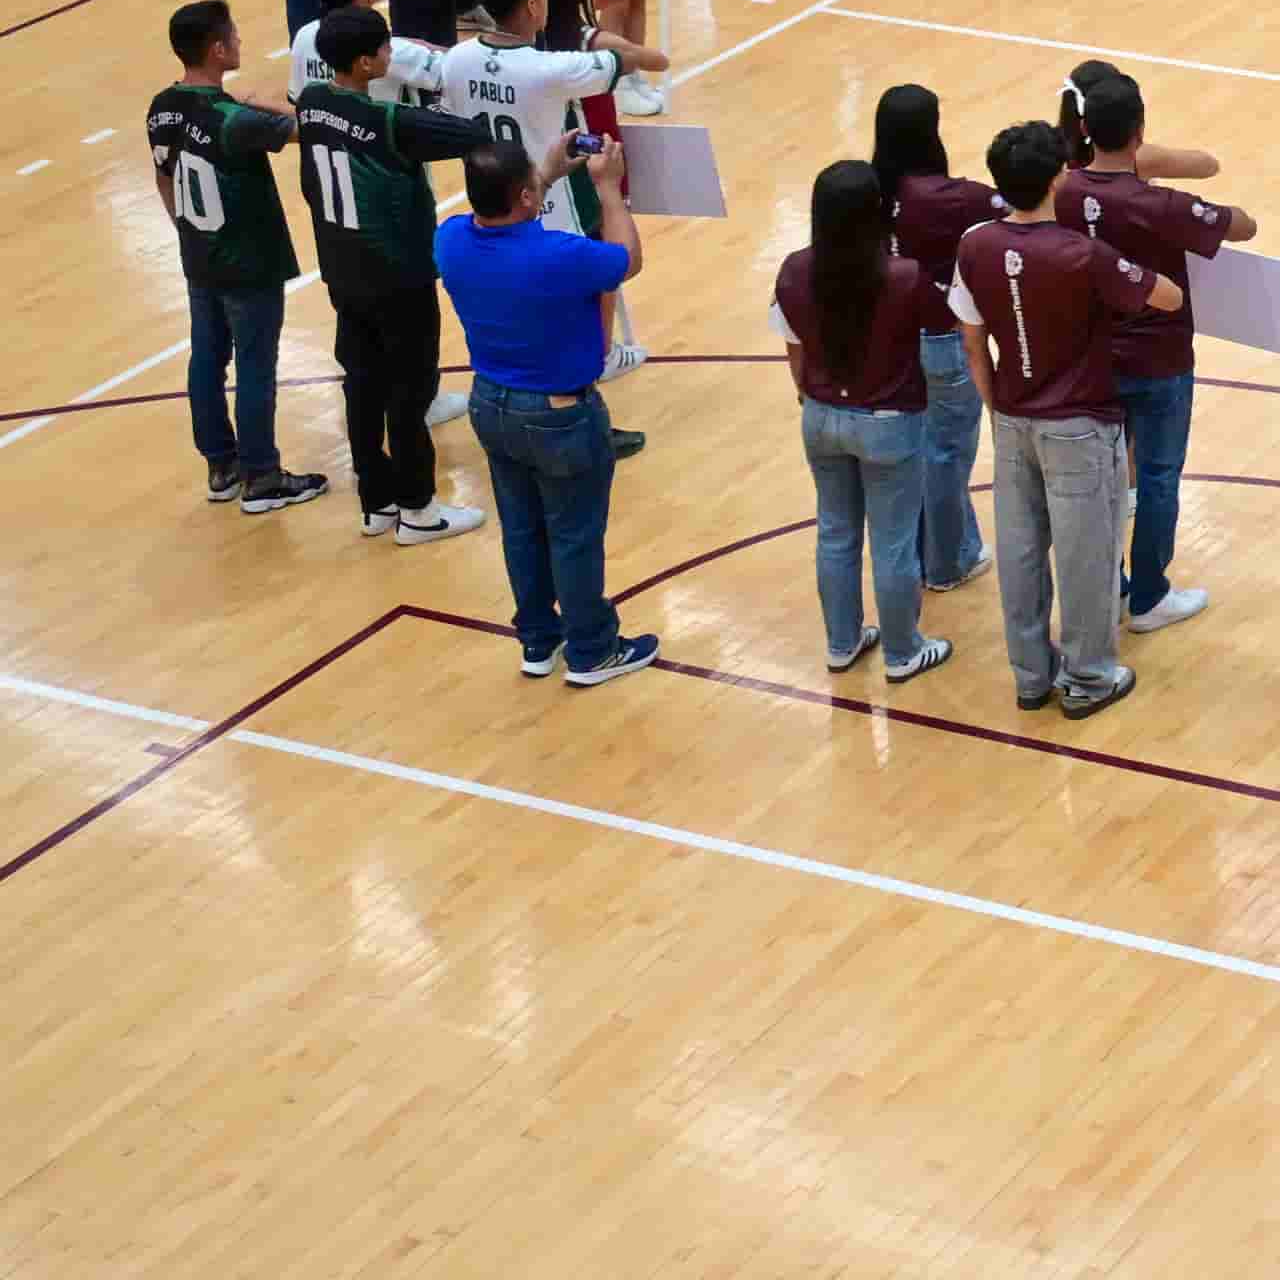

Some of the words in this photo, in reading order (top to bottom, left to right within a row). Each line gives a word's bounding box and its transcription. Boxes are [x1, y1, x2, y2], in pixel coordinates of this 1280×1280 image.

[306, 58, 337, 81] MISA
[469, 80, 516, 105] PABLO
[309, 109, 350, 133] SUPERIOR
[351, 125, 377, 142] SLP
[311, 142, 360, 230] 11
